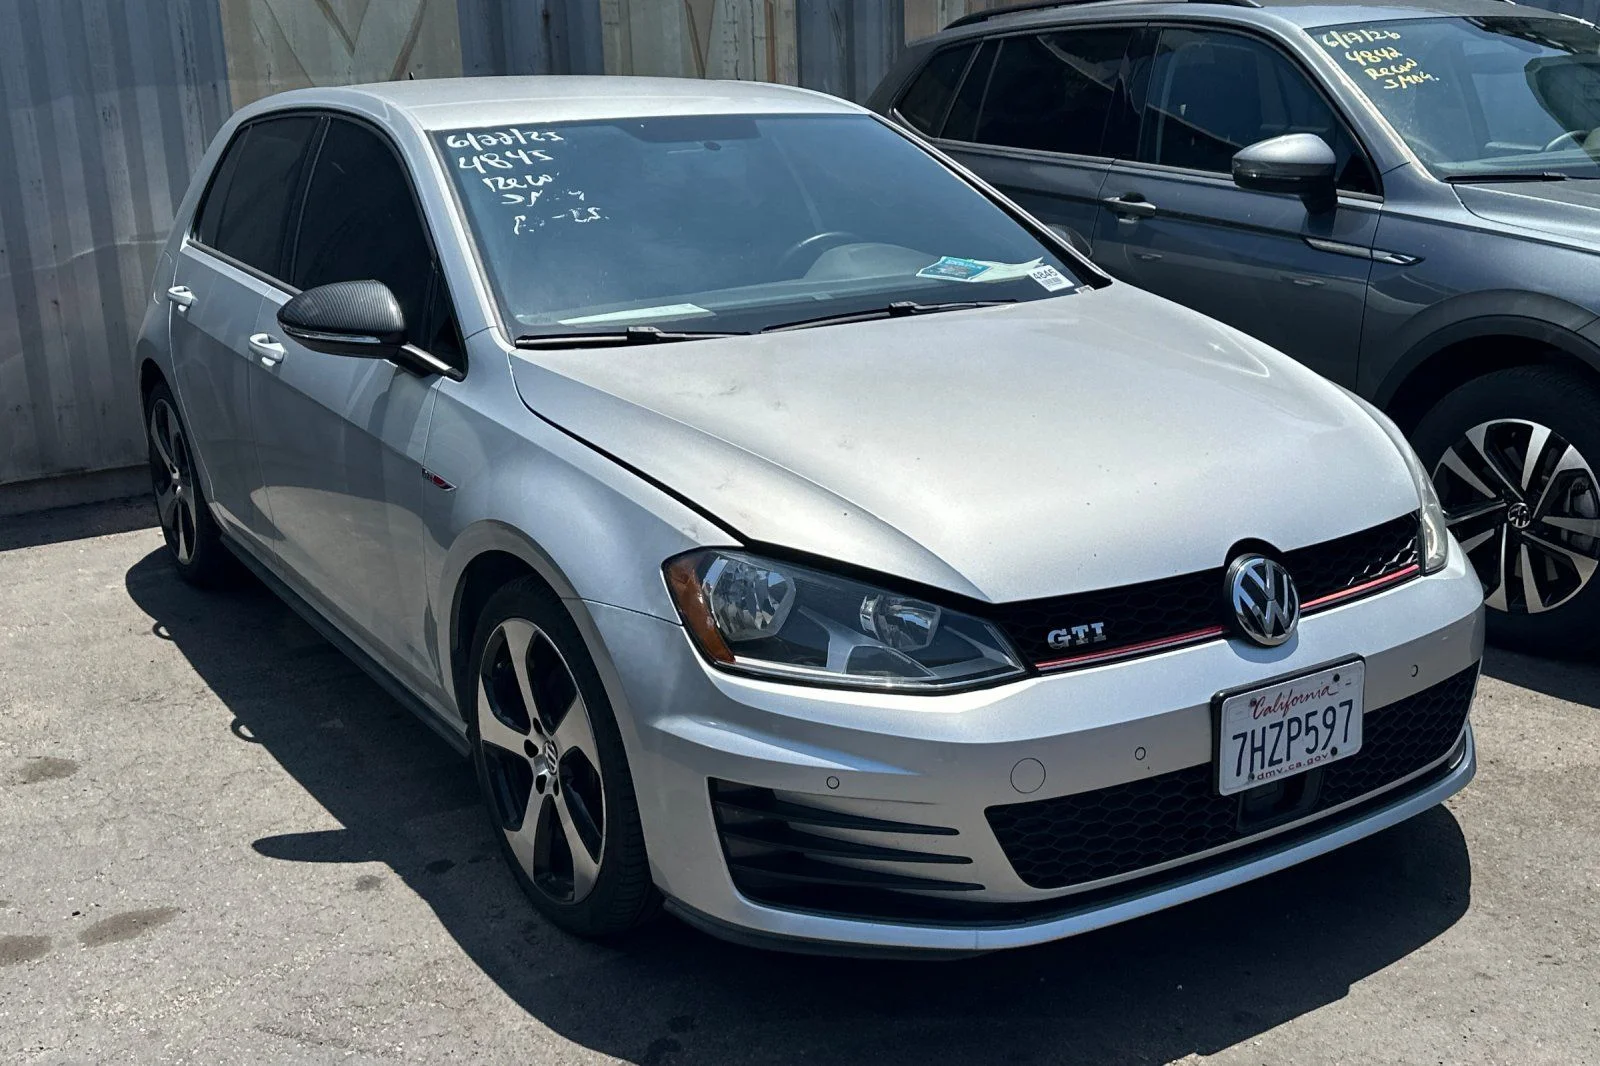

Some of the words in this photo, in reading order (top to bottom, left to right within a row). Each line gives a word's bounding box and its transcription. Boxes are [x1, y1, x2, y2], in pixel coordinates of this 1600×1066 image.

[458, 149, 554, 174] 4845
[1048, 622, 1107, 650] GTI
[1251, 682, 1338, 720] California
[1232, 699, 1353, 777] 7HZP597
[1257, 752, 1329, 781] dmv.ca.gov
